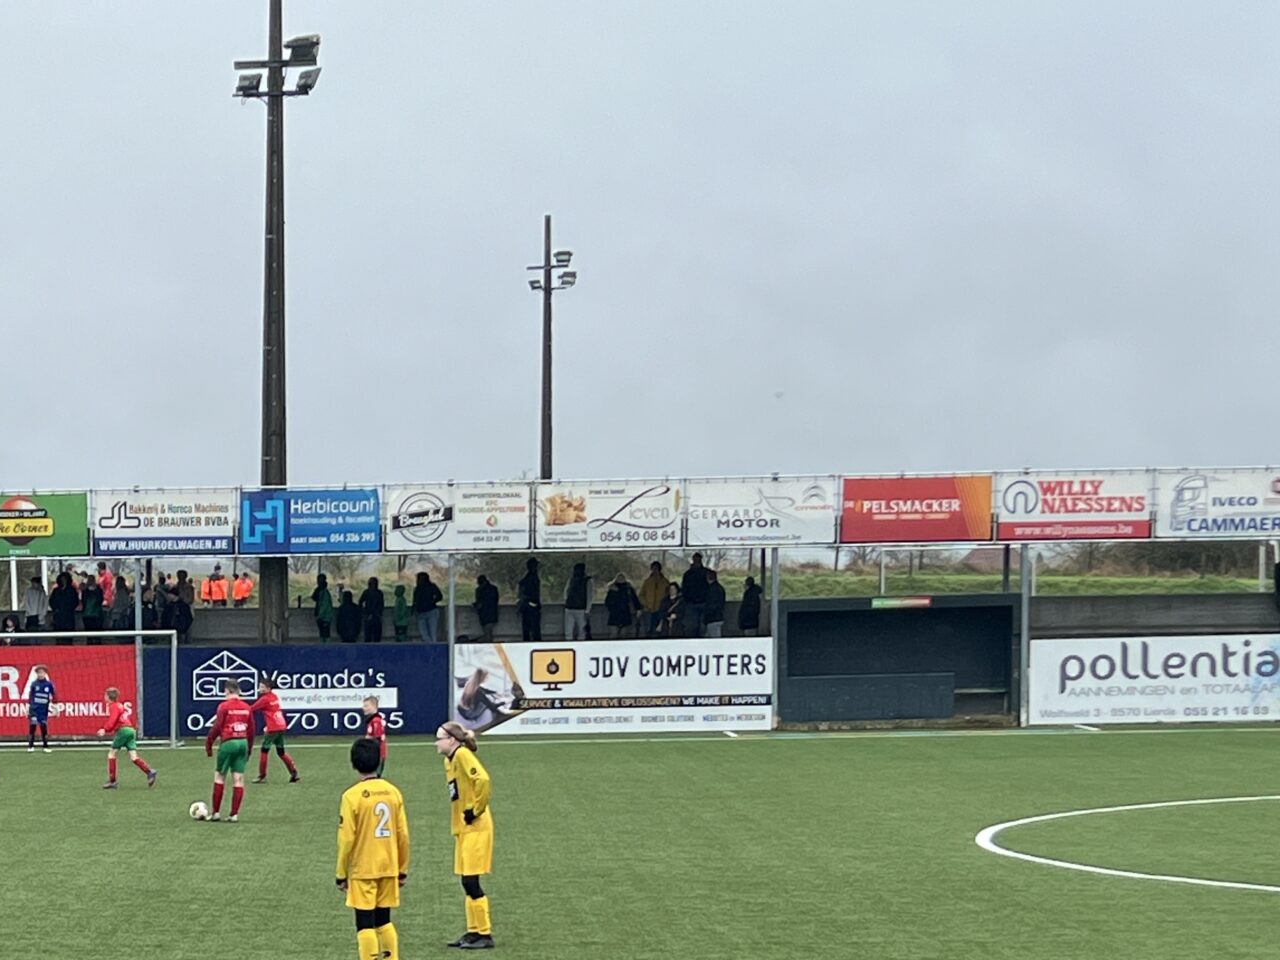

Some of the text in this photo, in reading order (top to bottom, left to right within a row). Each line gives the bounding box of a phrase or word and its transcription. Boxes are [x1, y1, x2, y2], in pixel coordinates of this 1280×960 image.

[1037, 480, 1104, 497] WILLY
[290, 497, 376, 514] Herbicount
[863, 498, 960, 513] PELSMACKER
[1041, 496, 1145, 513] NAESSENS
[1212, 496, 1258, 507] IVECO
[167, 504, 193, 514] Horeca
[194, 503, 229, 513] Machines
[691, 509, 763, 520] GERAARD
[12, 521, 49, 533] Corner
[143, 516, 229, 528] DE BRAUWER BVBA
[717, 519, 780, 528] MOTOR
[600, 530, 676, 542] 054 50 08 64
[589, 653, 767, 678] JDV COMPUTERS
[1059, 639, 1279, 694] pollentia
[1067, 686, 1176, 697] AANNEMINGEN
[682, 696, 696, 706] WE
[696, 695, 721, 706] MAKE
[1183, 706, 1208, 717] 055
[1211, 706, 1229, 716] 21
[331, 711, 361, 730] 10
[374, 801, 391, 838] 2
